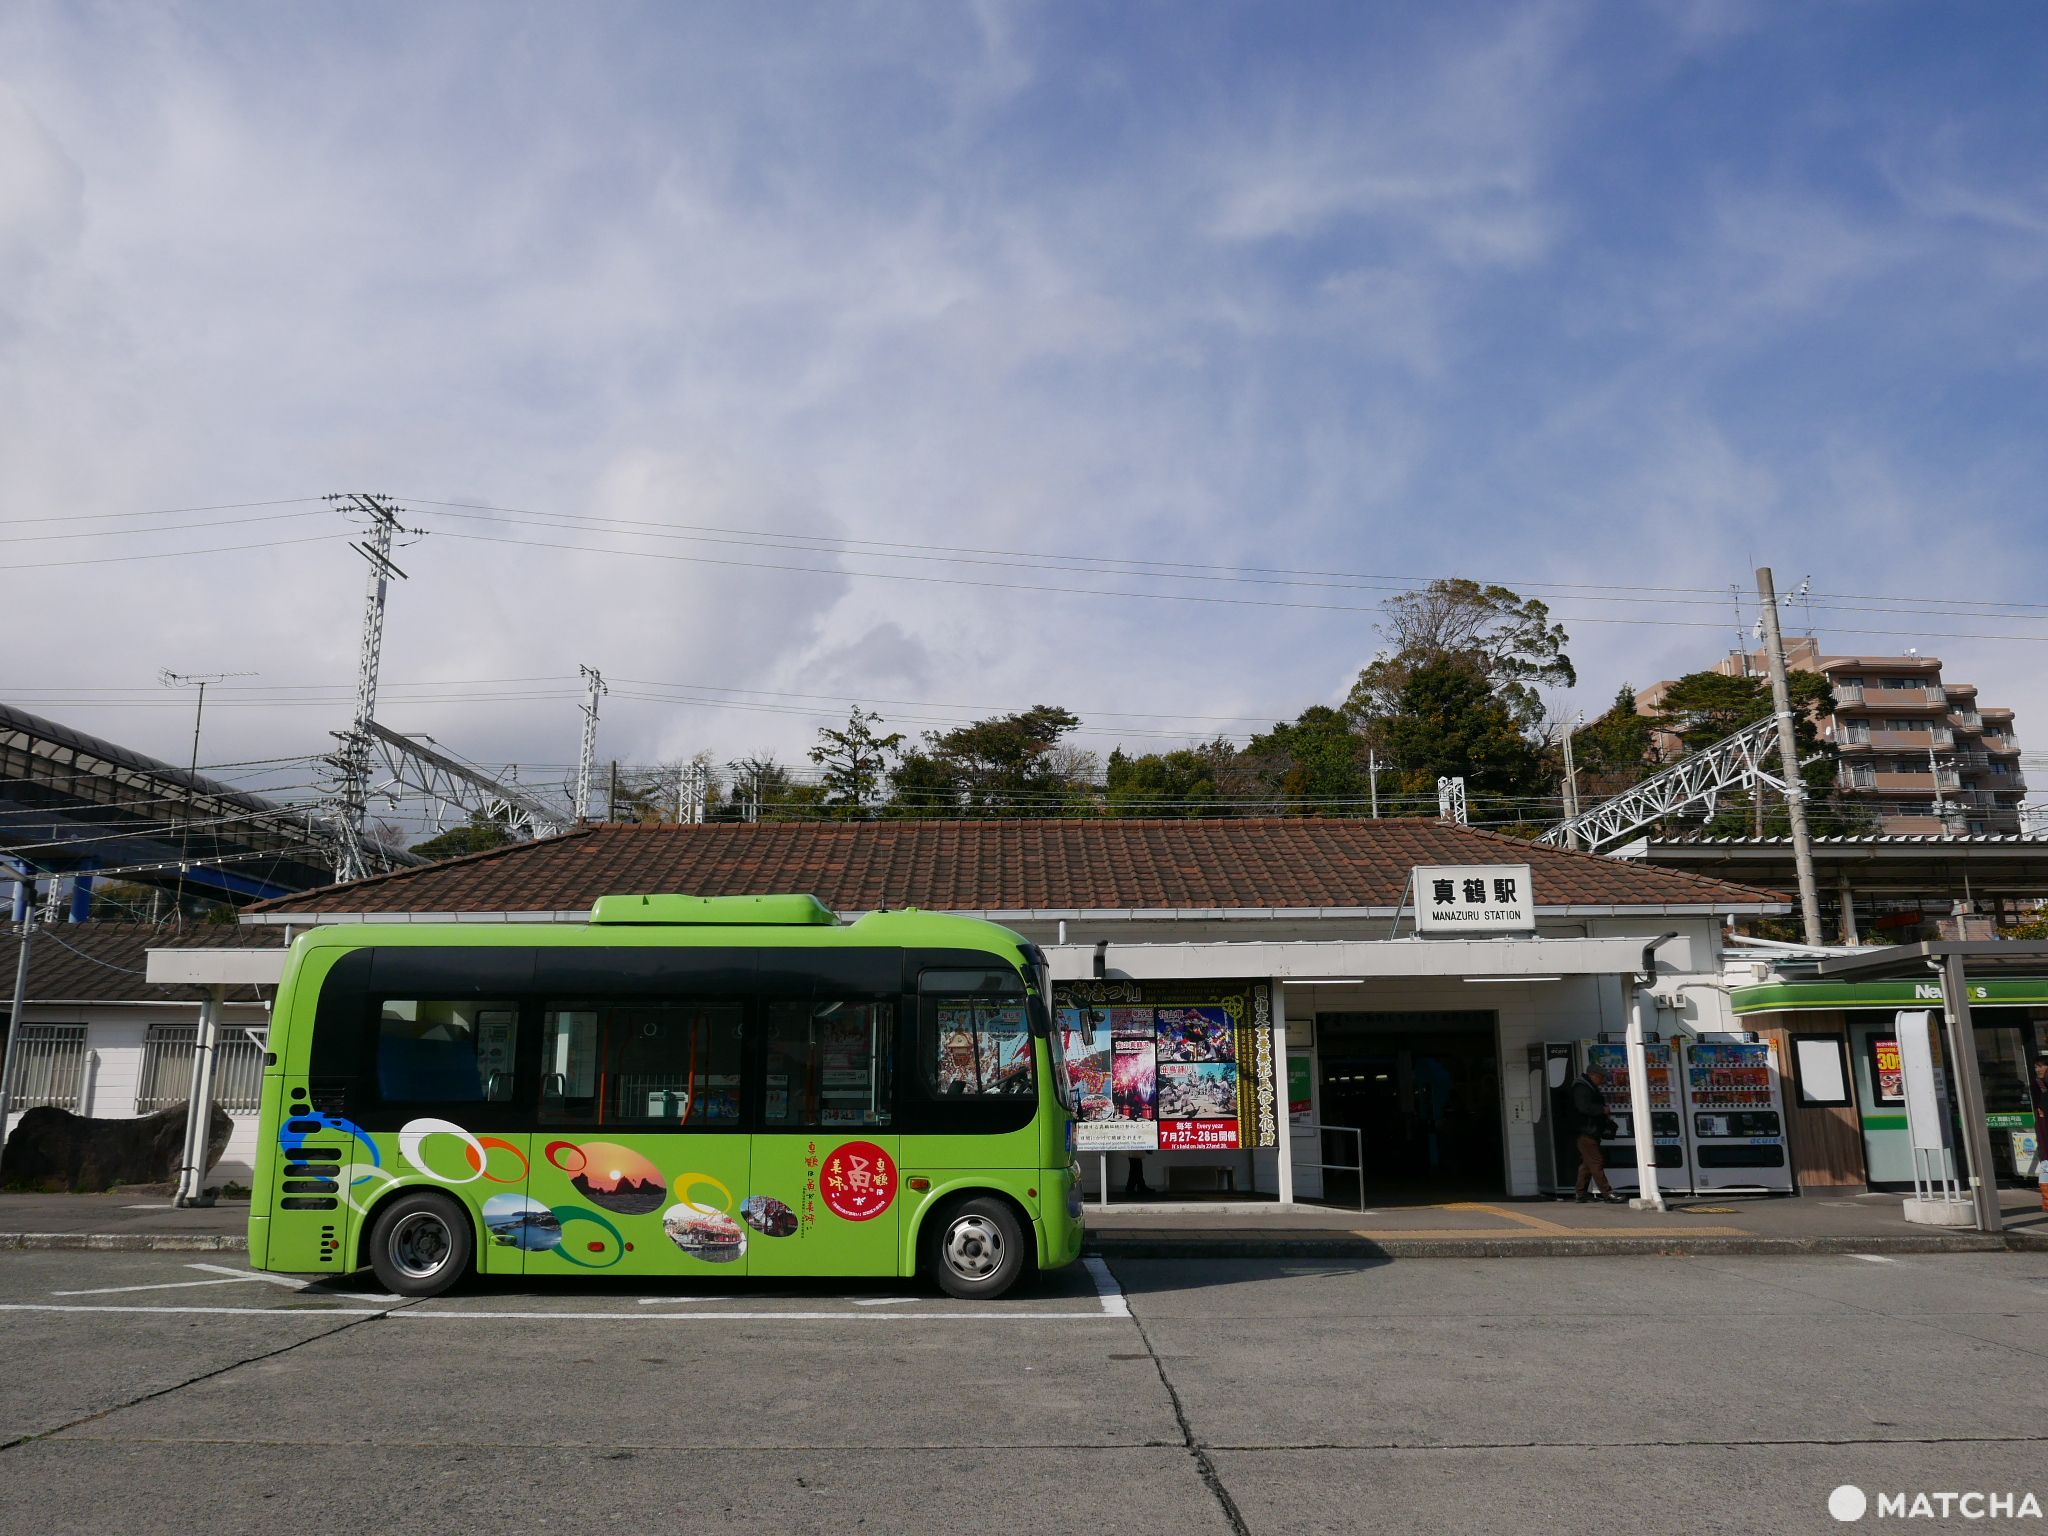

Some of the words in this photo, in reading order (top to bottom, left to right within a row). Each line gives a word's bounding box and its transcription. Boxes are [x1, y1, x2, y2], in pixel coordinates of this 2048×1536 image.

[1432, 878, 1517, 905] 真鶴駅
[1432, 911, 1480, 921] MANAZURU
[1484, 910, 1521, 921] STATION
[1176, 1121, 1193, 1130] 毎年
[1197, 1122, 1212, 1131] Every
